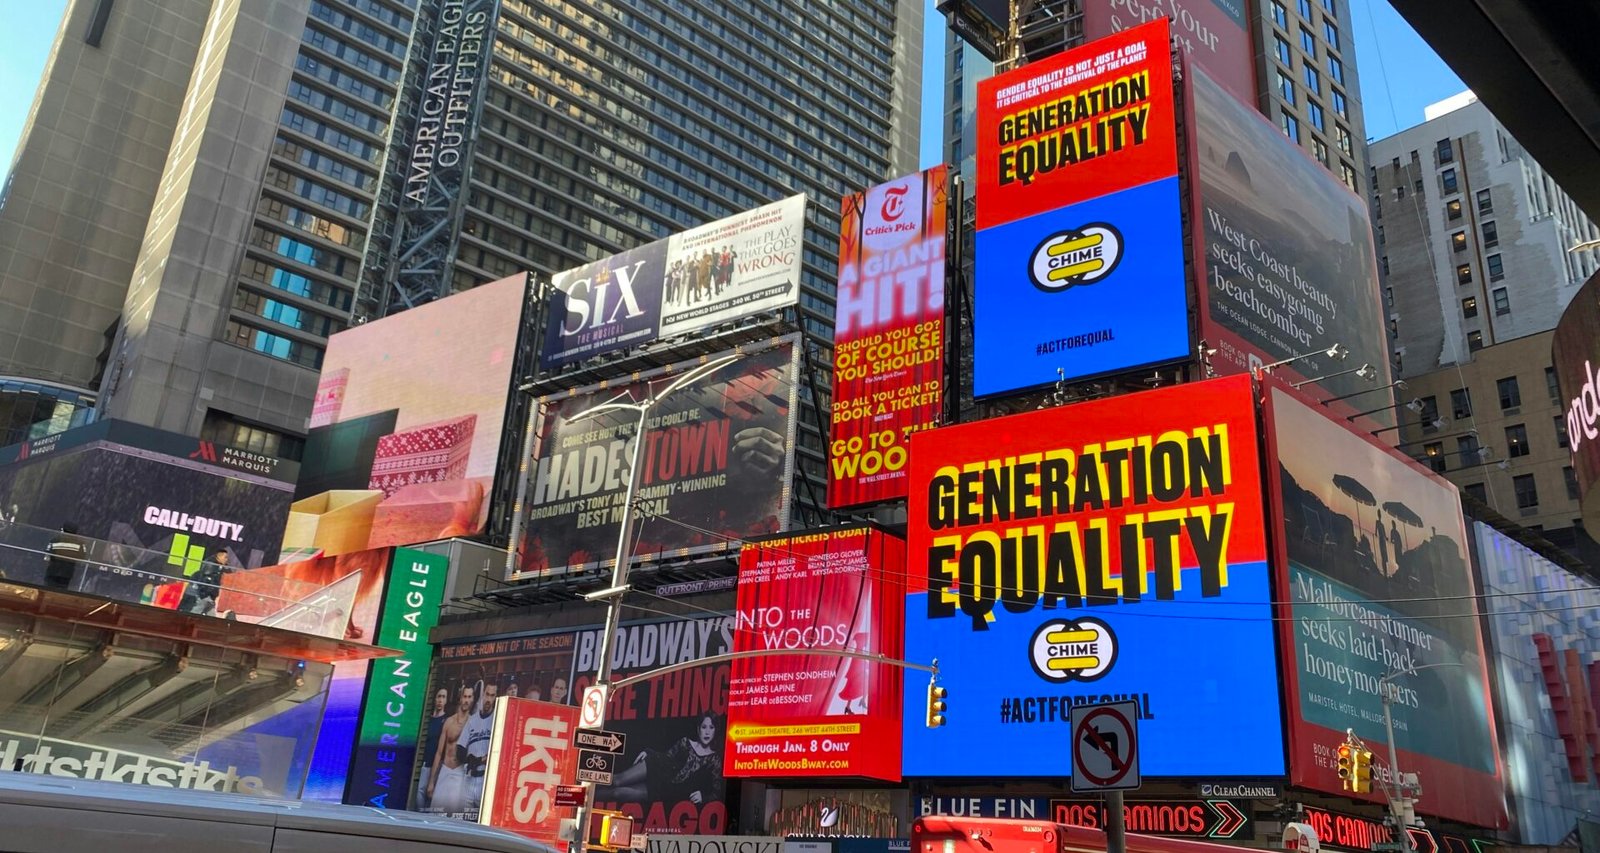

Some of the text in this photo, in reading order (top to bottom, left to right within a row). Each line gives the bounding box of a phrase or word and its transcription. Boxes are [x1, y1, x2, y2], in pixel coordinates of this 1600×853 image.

[1168, 0, 1219, 53] your
[996, 51, 1147, 109] IT IS CRITICAL TO THE SURVIVAL OF THE PLANET
[997, 41, 1147, 100] GENDER EQUALITY IS NOT JUST A GOAL
[438, 11, 486, 167] OUTFITTERS
[999, 69, 1150, 146] GENERATION
[404, 63, 451, 204] AMERICAN
[999, 102, 1151, 186] EQUALITY
[684, 228, 719, 243] BROADWAY'S
[771, 208, 782, 217] HIT
[694, 216, 783, 247] INTERNATIONAL PHENOMENON
[745, 224, 793, 248] THE PLAY
[865, 222, 916, 236] Critic's Pick
[740, 235, 797, 260] THAT GOES
[1048, 246, 1103, 269] CHIME
[737, 252, 796, 275] WRONG
[840, 236, 944, 286] A GIANT
[1207, 207, 1338, 319] West Coast beauty
[835, 260, 944, 333] HIT!
[1212, 243, 1325, 335] seeks easygoing
[689, 307, 709, 318] WORLD
[709, 302, 729, 312] STAGES
[732, 298, 744, 306] 340
[765, 286, 785, 297] STREET
[1214, 265, 1313, 348] beachcomber
[578, 326, 624, 345] THE MUSICAL
[885, 320, 941, 341] YOU GO?
[1217, 301, 1293, 354] THE OCEAN CANNON
[836, 331, 941, 369] OF COURSE
[1036, 328, 1115, 356] #ACTFOREQUAL
[1220, 340, 1246, 361] BOOK ON
[1221, 349, 1246, 369] THE APP
[836, 364, 867, 383] YOU
[851, 380, 940, 408] ALL YOU CAN TO
[833, 405, 872, 424] BOOK
[877, 402, 886, 415] A
[33, 434, 61, 447] MARRIOTT
[562, 411, 687, 449] COME SEE HOW THE COULD
[869, 430, 895, 449] TO
[30, 444, 56, 456] MARQUIS
[224, 447, 279, 466] MARRIOTT
[222, 456, 270, 473] MARQUIS
[831, 446, 907, 480] WOO
[928, 424, 1232, 530] GENERATION
[144, 506, 189, 531] CALL
[531, 499, 585, 521] BROADWAY'S
[577, 508, 607, 529] BEST
[791, 527, 872, 545] TICKETS TODAY!
[777, 558, 796, 566] MILLER
[808, 549, 864, 562] MONTEGO GLOVER
[847, 556, 868, 565] JAMES
[927, 502, 1234, 631] EQUALITY
[742, 565, 796, 578] STEPHANIE BLOCK
[754, 569, 807, 583] CREEL ANDY KARL
[812, 567, 834, 576] KRYSTA
[658, 579, 733, 595] OUTFRONT PRIME
[735, 605, 811, 630] INTO THE
[1297, 572, 1432, 651] Mallorcan stunner
[441, 647, 454, 658] THE
[455, 643, 495, 657] HOME-RUN
[496, 642, 508, 653] HIT
[510, 640, 520, 652] OF
[522, 639, 537, 651] THE
[762, 623, 847, 651] WOODS
[1301, 615, 1419, 677] seeks laid-back
[1047, 643, 1099, 656] CHIME
[369, 561, 430, 809] AMERICAN EAGLE
[764, 672, 794, 682] STEPHEN
[796, 670, 837, 681] SONDHEIM
[746, 685, 768, 695] JAMES
[770, 684, 795, 693] LAPINE
[751, 697, 767, 705] LEAR
[1308, 692, 1339, 711] MARISTEL
[1392, 718, 1408, 731] SPAIN
[581, 734, 618, 747] ONE WAY
[736, 742, 779, 754] THROUGH
[810, 740, 817, 752] 8
[822, 739, 850, 752] ONLY
[1313, 743, 1330, 757] BOOK
[513, 716, 568, 823] tkts
[1315, 756, 1328, 767] THE
[580, 770, 610, 782] BIKE LANE
[920, 798, 1035, 819] BLUE FIN
[1056, 805, 1096, 829] DOS
